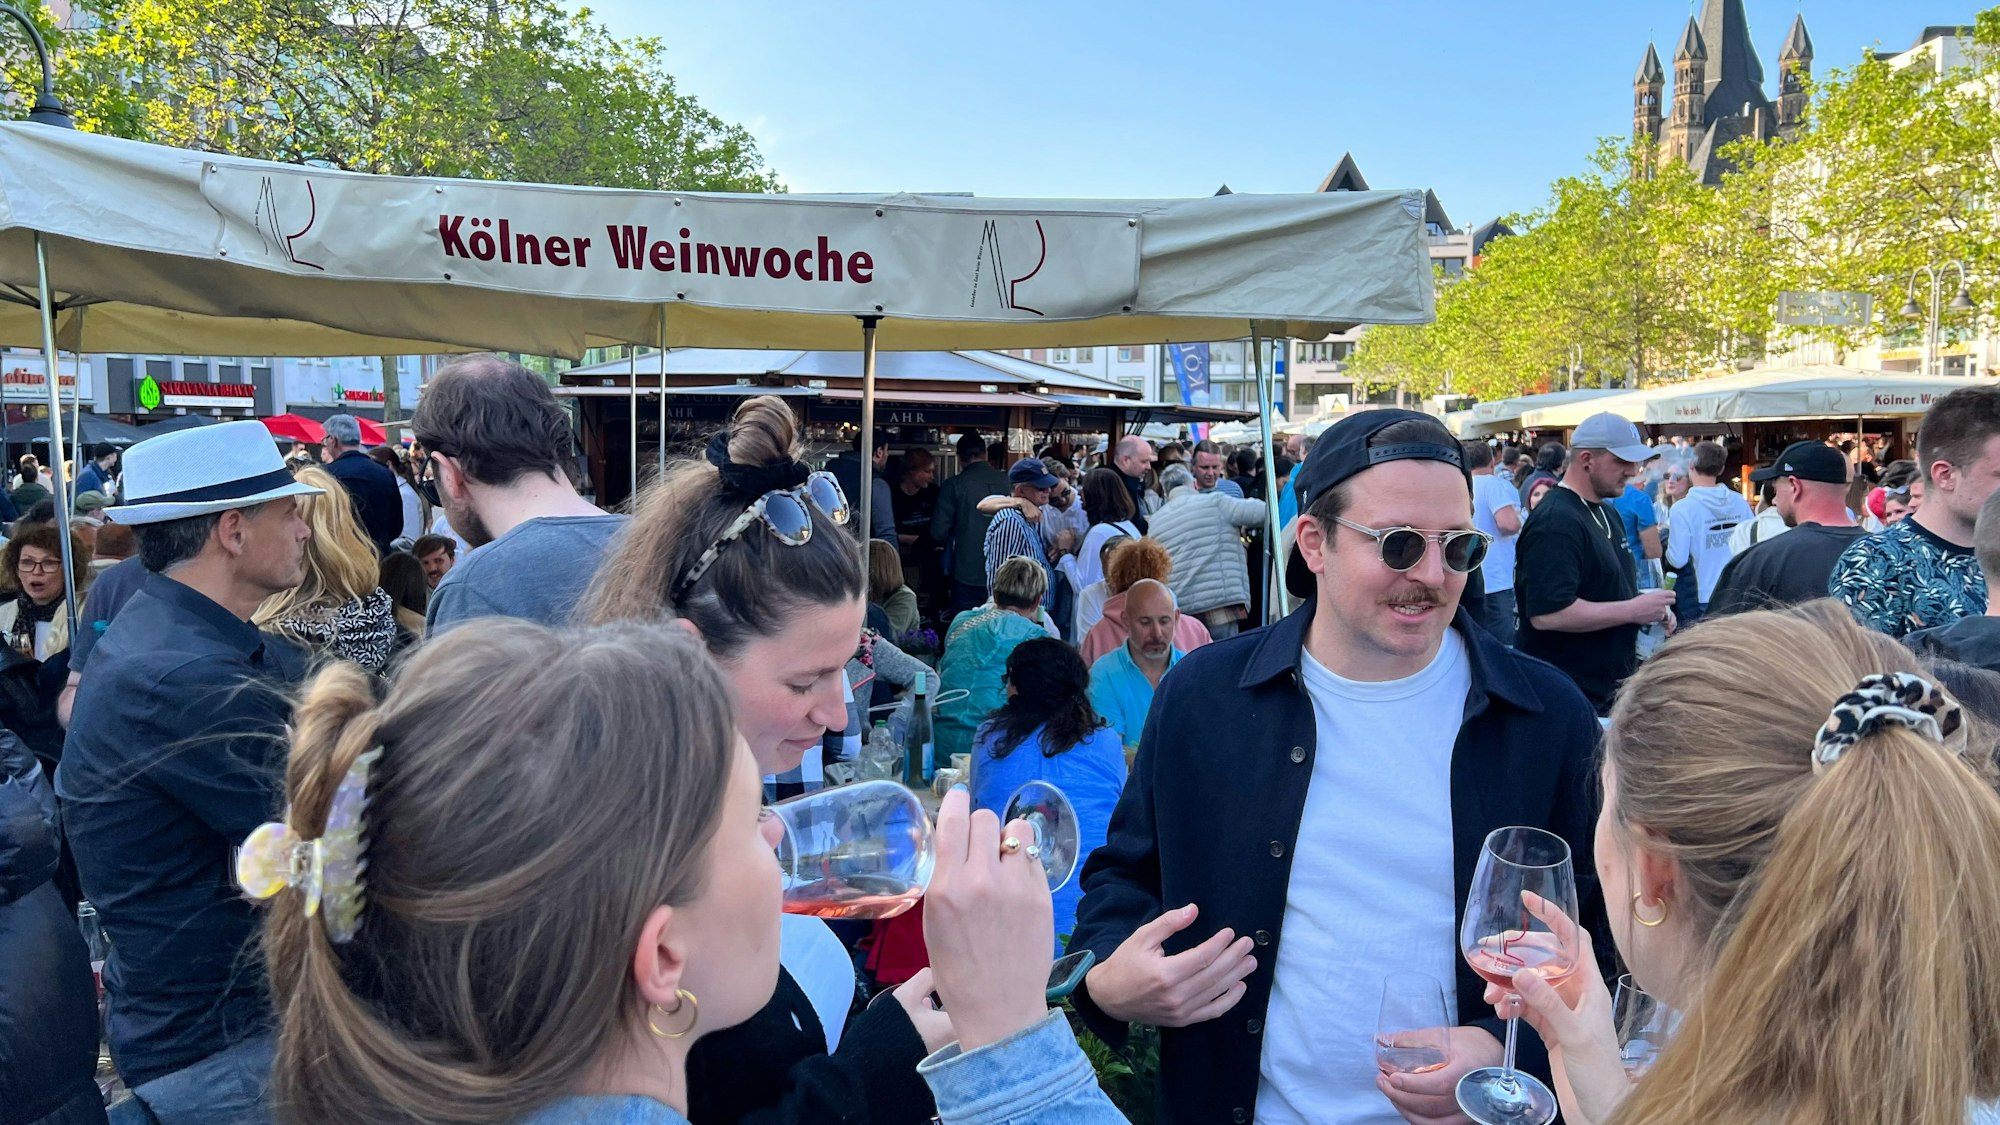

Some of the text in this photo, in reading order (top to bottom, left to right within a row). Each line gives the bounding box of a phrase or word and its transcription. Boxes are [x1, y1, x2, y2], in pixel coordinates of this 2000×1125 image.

[438, 214, 874, 284] Kölner Weinwoche
[1874, 393, 1916, 405] Kölner
[665, 407, 694, 418] AHR
[890, 412, 926, 423] AHR
[1065, 417, 1081, 428] AHR
